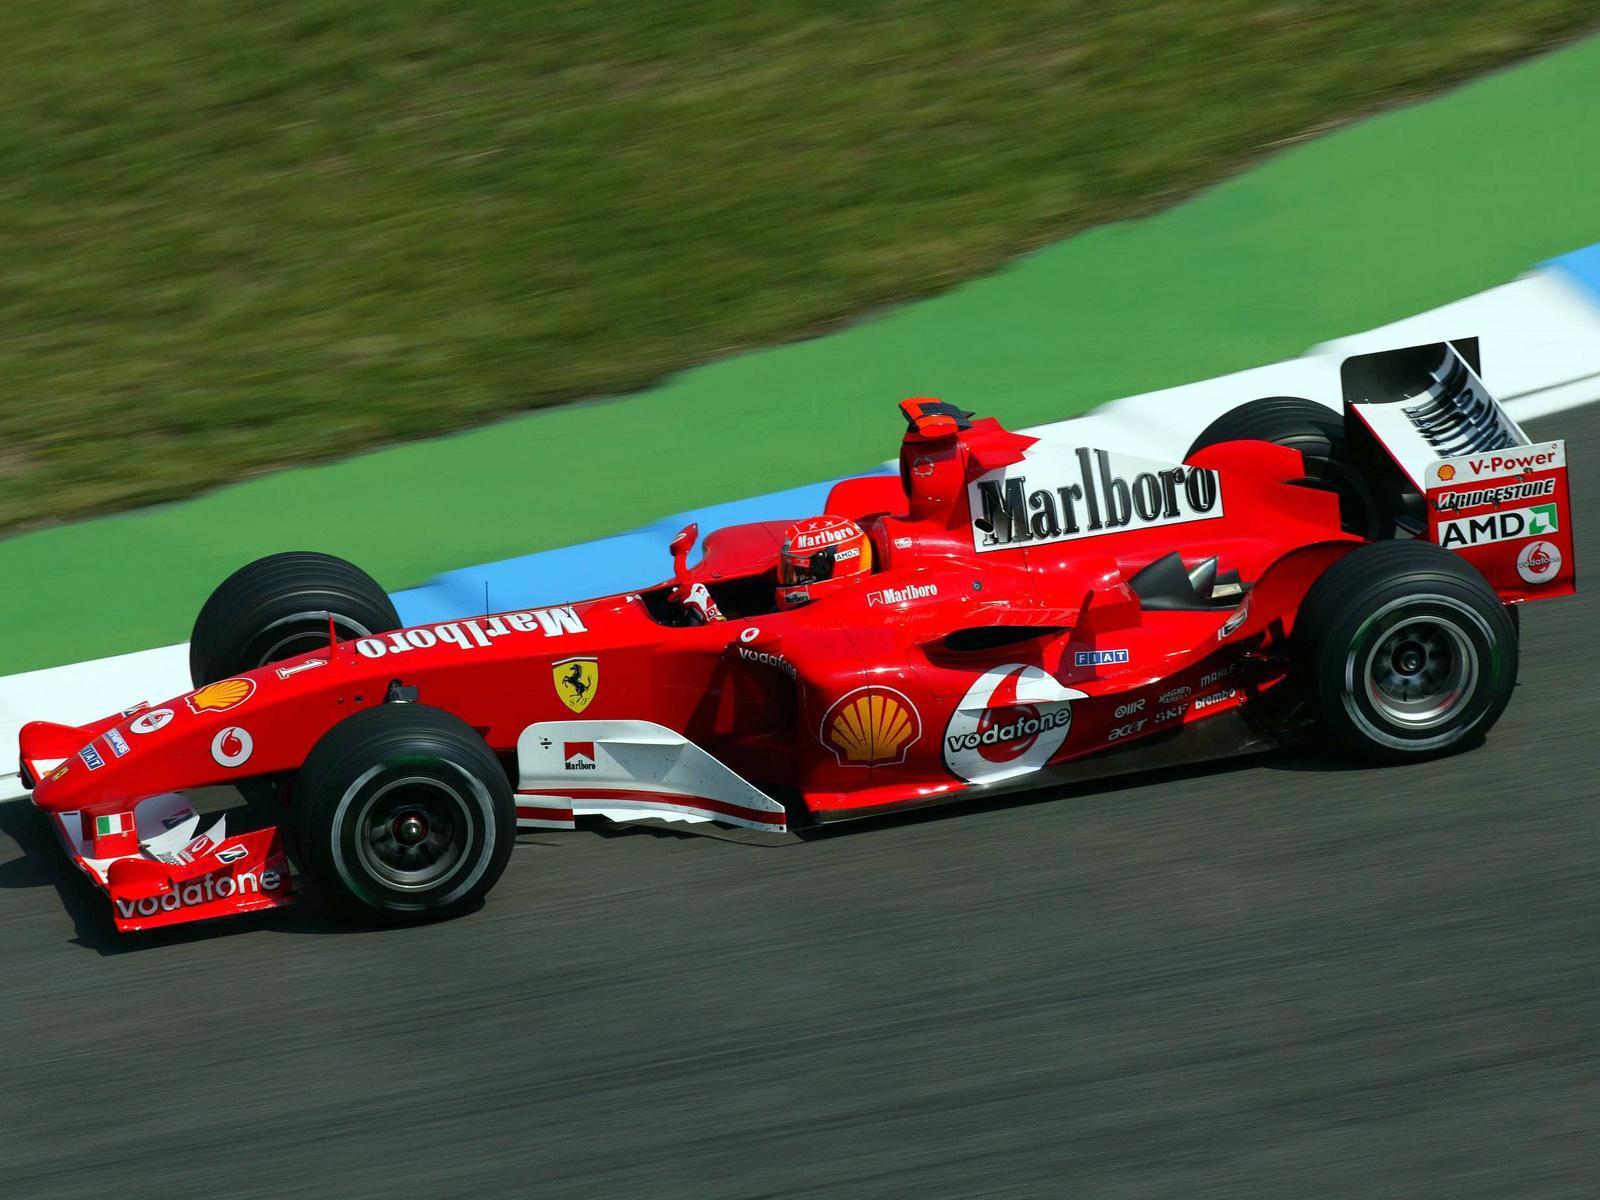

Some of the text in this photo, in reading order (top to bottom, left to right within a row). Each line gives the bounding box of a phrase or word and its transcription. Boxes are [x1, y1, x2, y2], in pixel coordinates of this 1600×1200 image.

[1470, 451, 1555, 475] V-Power
[976, 446, 1218, 545] Marlboro
[1437, 478, 1555, 512] BRIDGESTONE
[798, 526, 854, 548] Marlboro
[1442, 512, 1525, 548] AMD
[883, 583, 938, 605] Marlboro
[355, 606, 588, 659] Marlboro
[1076, 649, 1128, 665] FIAT
[1195, 687, 1236, 709] brembo
[946, 707, 1072, 752] vodafone
[565, 759, 596, 770] Marlboro
[115, 869, 282, 919] vodafone
